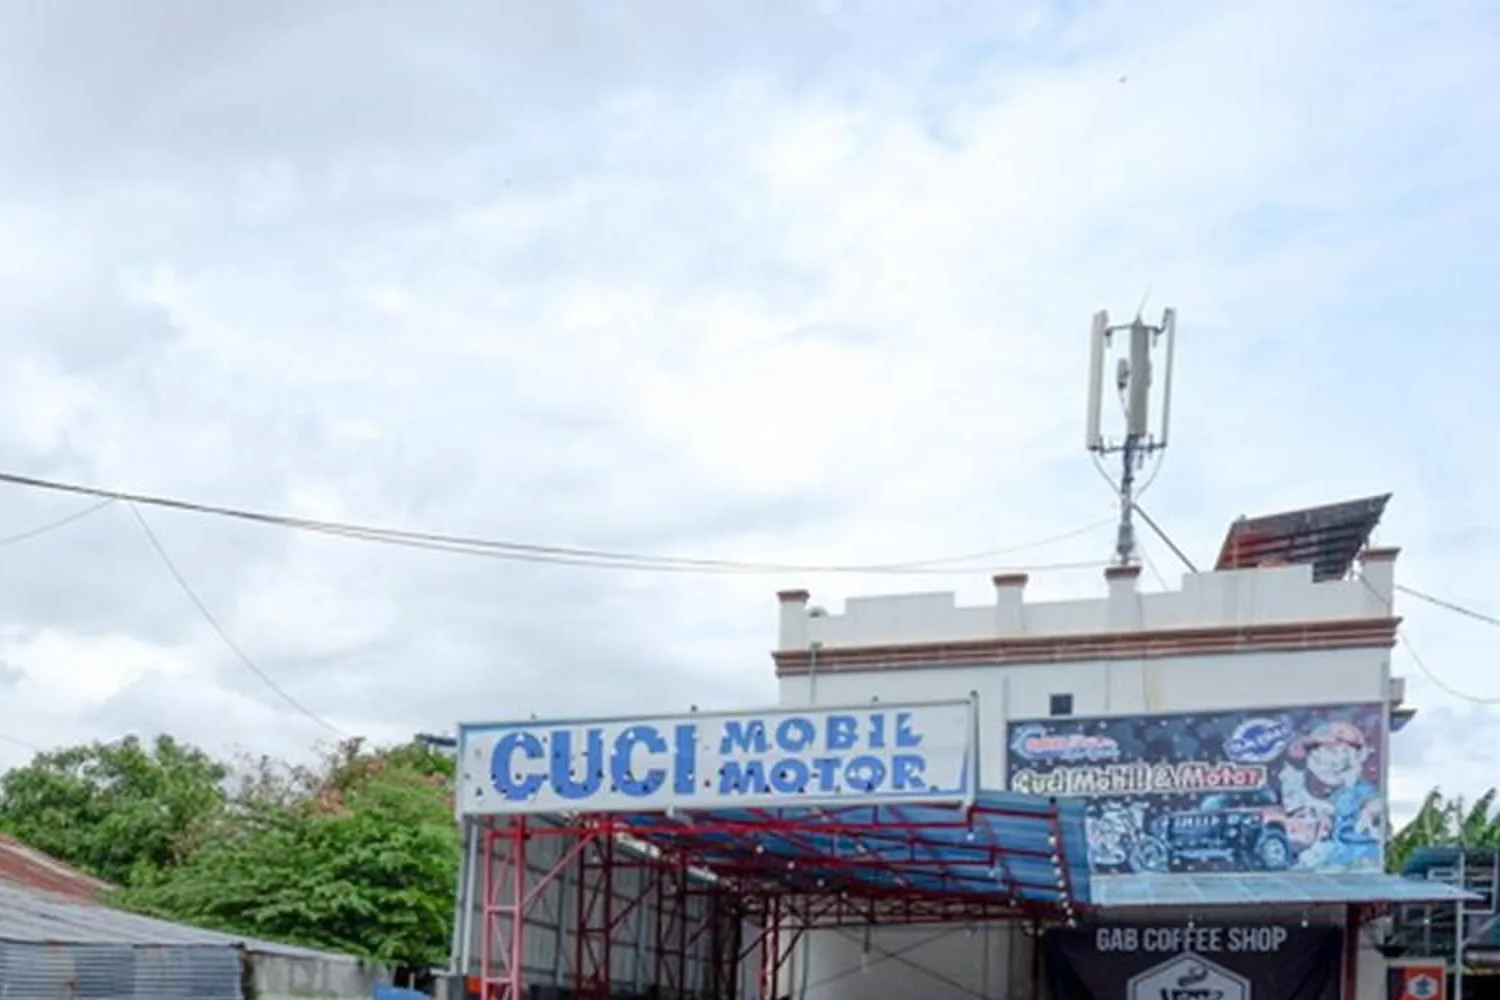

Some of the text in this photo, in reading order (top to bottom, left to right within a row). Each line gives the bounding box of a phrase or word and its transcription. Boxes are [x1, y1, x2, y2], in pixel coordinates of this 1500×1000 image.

[719, 712, 923, 755] MOBIL
[490, 724, 699, 801] CUCI
[719, 754, 928, 795] MOTOR
[1180, 764, 1263, 790] Motor
[1096, 926, 1287, 951] GAB COFFEE SHOP
